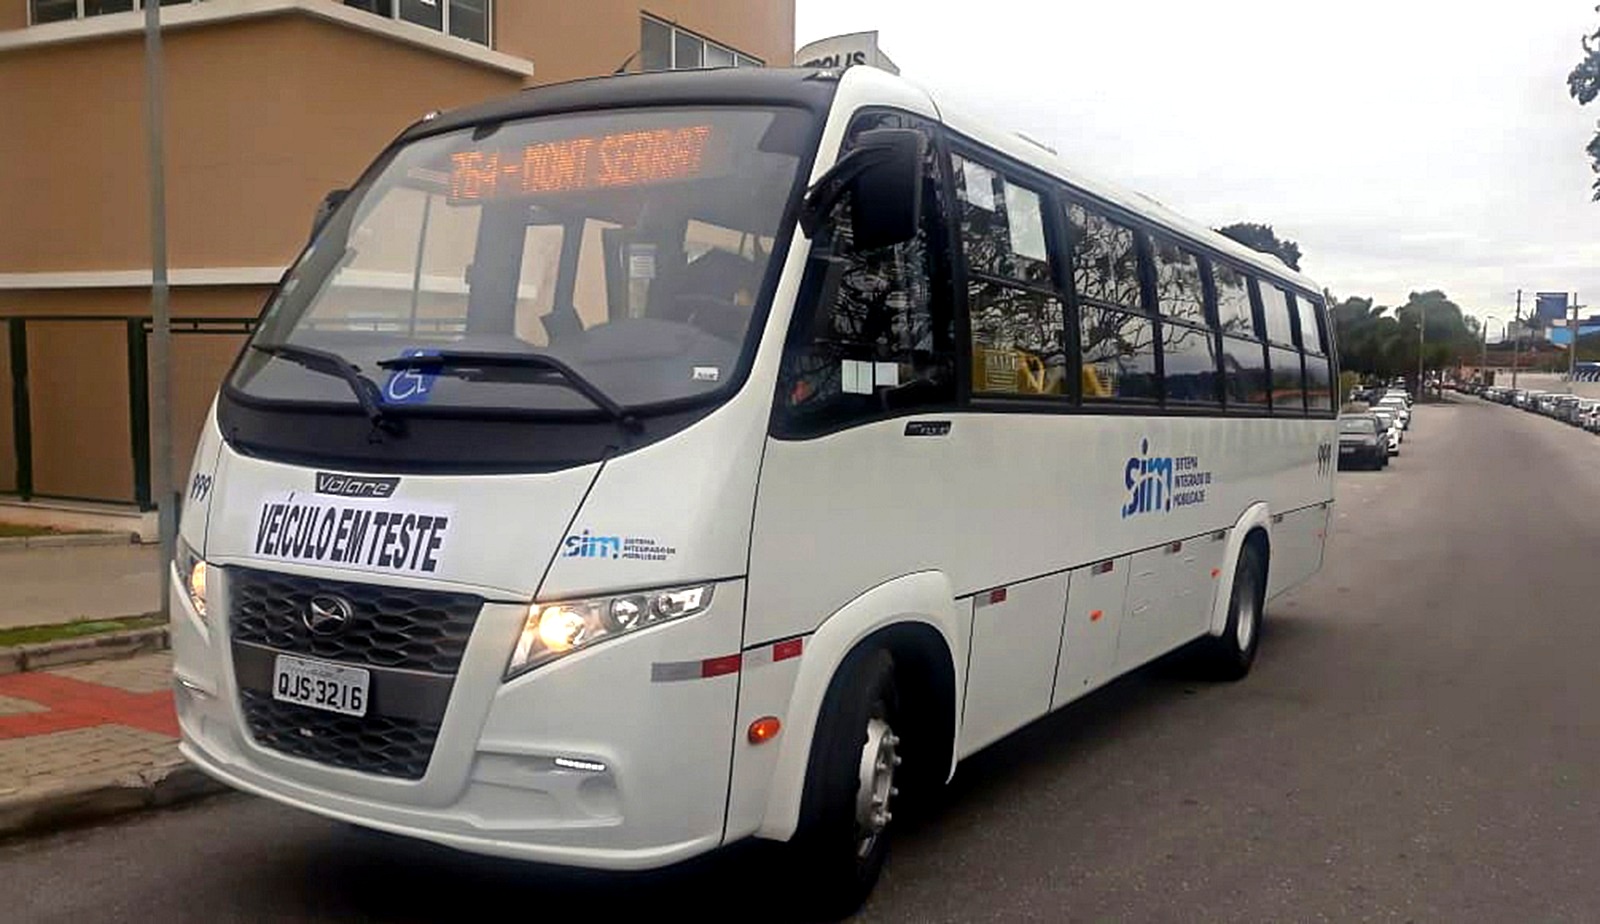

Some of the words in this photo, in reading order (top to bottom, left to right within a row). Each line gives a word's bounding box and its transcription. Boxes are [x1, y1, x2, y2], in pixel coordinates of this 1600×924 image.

[598, 126, 711, 187] SERRAT
[190, 472, 212, 502] 999
[319, 475, 390, 496] Volare
[255, 492, 336, 560] VEÍCULO
[330, 509, 372, 564] EM
[367, 511, 448, 572] TESTE
[563, 529, 619, 559] sim
